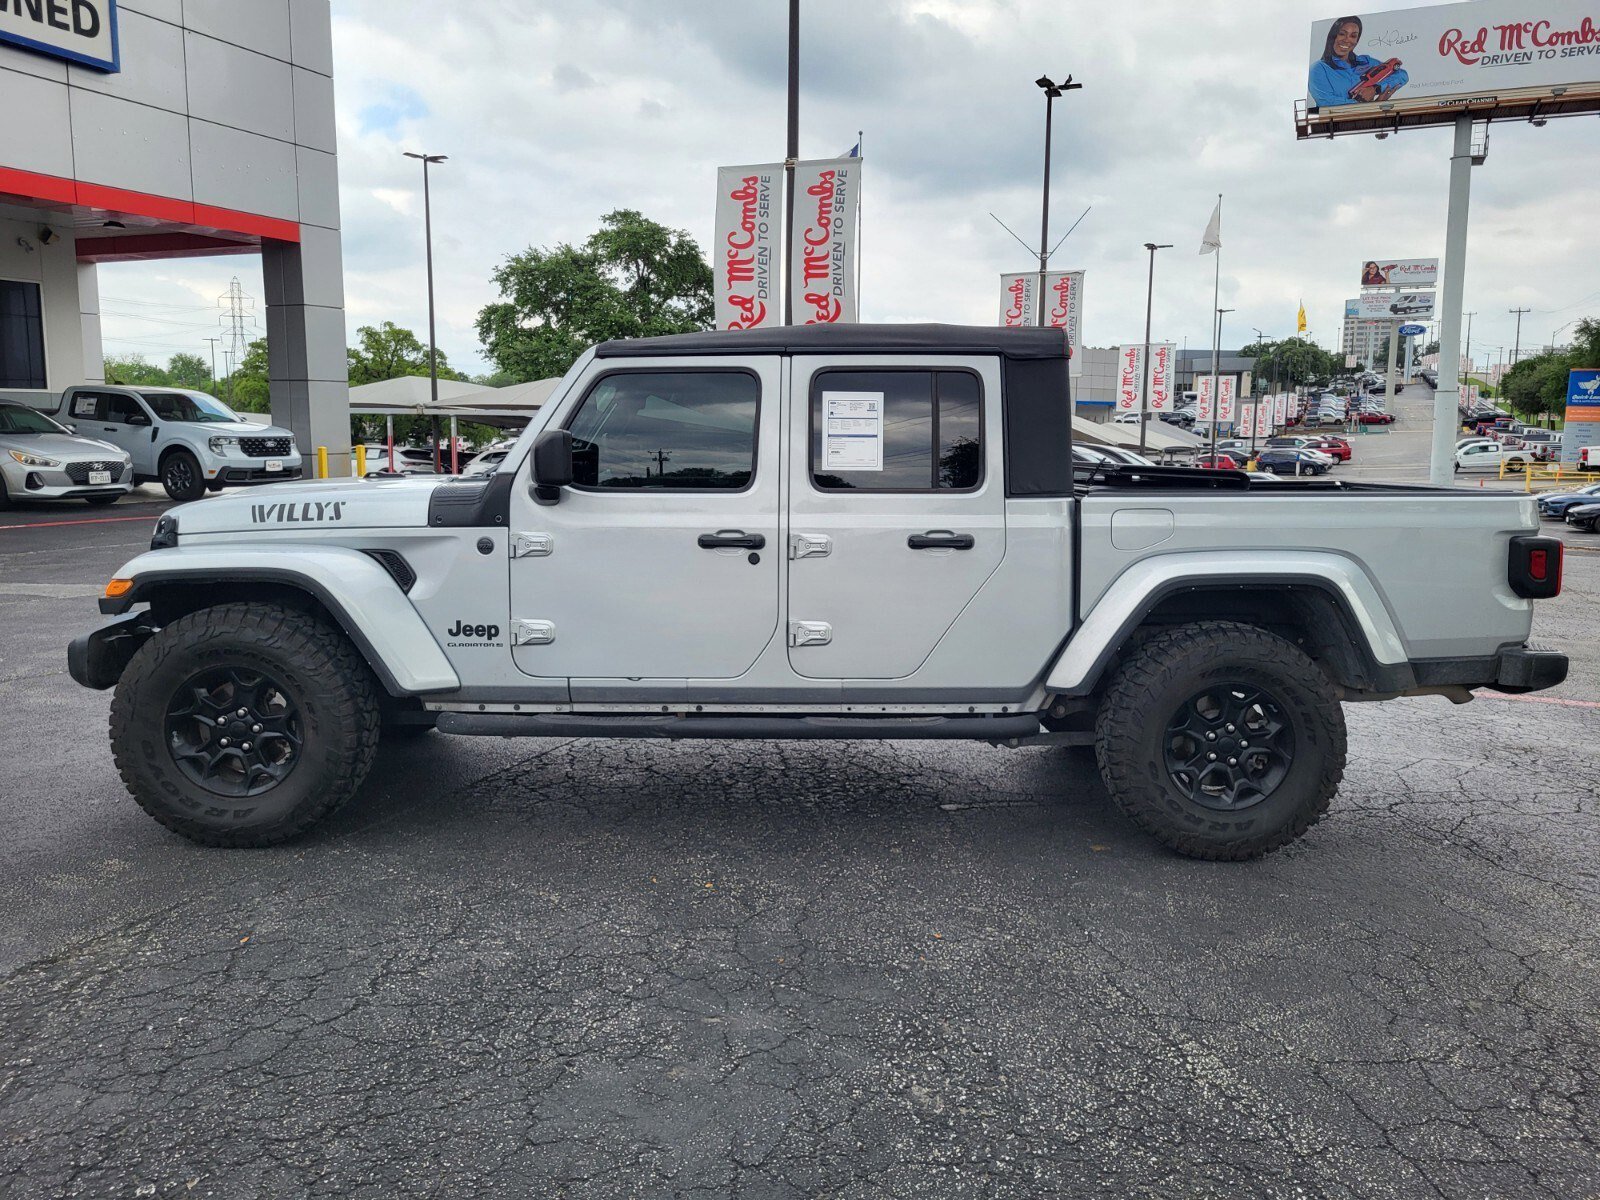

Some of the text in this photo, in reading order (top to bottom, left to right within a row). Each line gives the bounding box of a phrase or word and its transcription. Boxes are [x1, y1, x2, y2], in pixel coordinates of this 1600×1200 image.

[1438, 26, 1488, 65] Red
[1481, 44, 1600, 66] DRIVEN TO SERVE
[727, 176, 758, 290] McCombs
[758, 176, 770, 299] DRIVEN TO SERVE
[804, 170, 836, 288] McCombs
[833, 170, 848, 296] DRIVEN TO SERVE
[1024, 304, 1030, 315] TO
[1069, 302, 1075, 314] TO
[1402, 326, 1421, 334] Ford
[1121, 348, 1137, 408] Red McCombs
[1152, 347, 1168, 408] Red McCombs
[1199, 406, 1210, 419] Red
[1220, 406, 1232, 419] Red
[251, 502, 346, 522] WILLYS
[448, 620, 500, 640] Jeep
